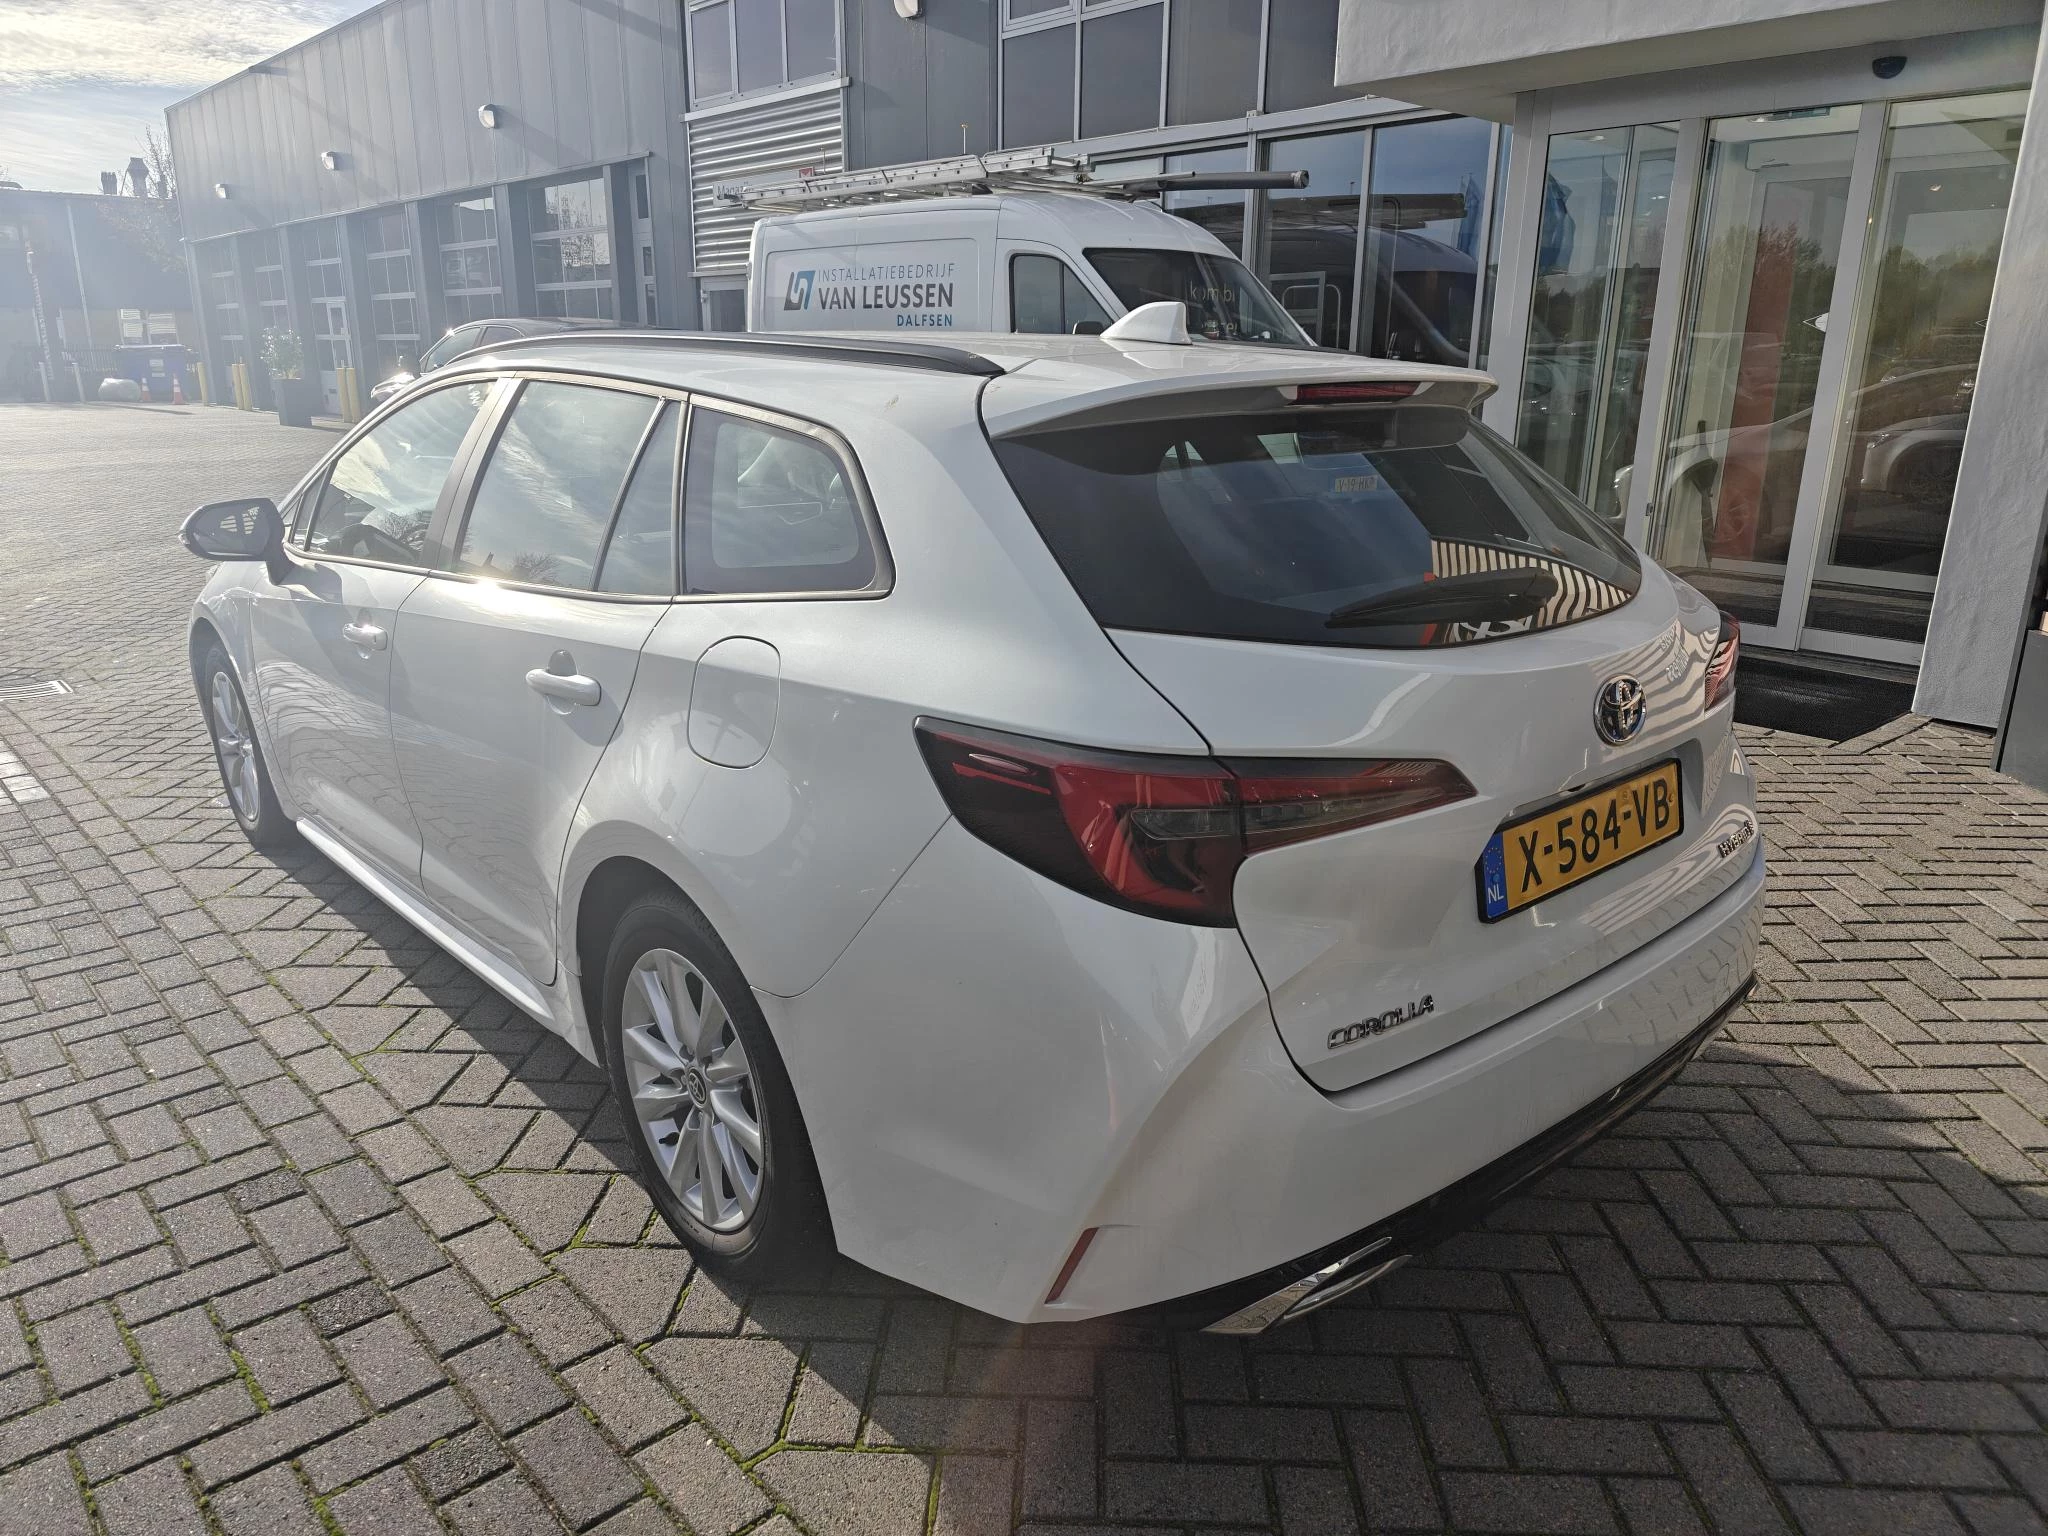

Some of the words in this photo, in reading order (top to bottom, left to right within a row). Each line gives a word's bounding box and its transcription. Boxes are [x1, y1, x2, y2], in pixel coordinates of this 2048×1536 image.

[818, 263, 955, 282] INSTALLATIEBEDRIJF
[818, 286, 856, 310] VAN
[862, 283, 954, 309] LEUSSEN
[897, 314, 953, 327] DALFSEN
[1518, 777, 1670, 893] X-584-VB
[1487, 884, 1504, 904] NL
[1327, 994, 1435, 1050] COROLLA
